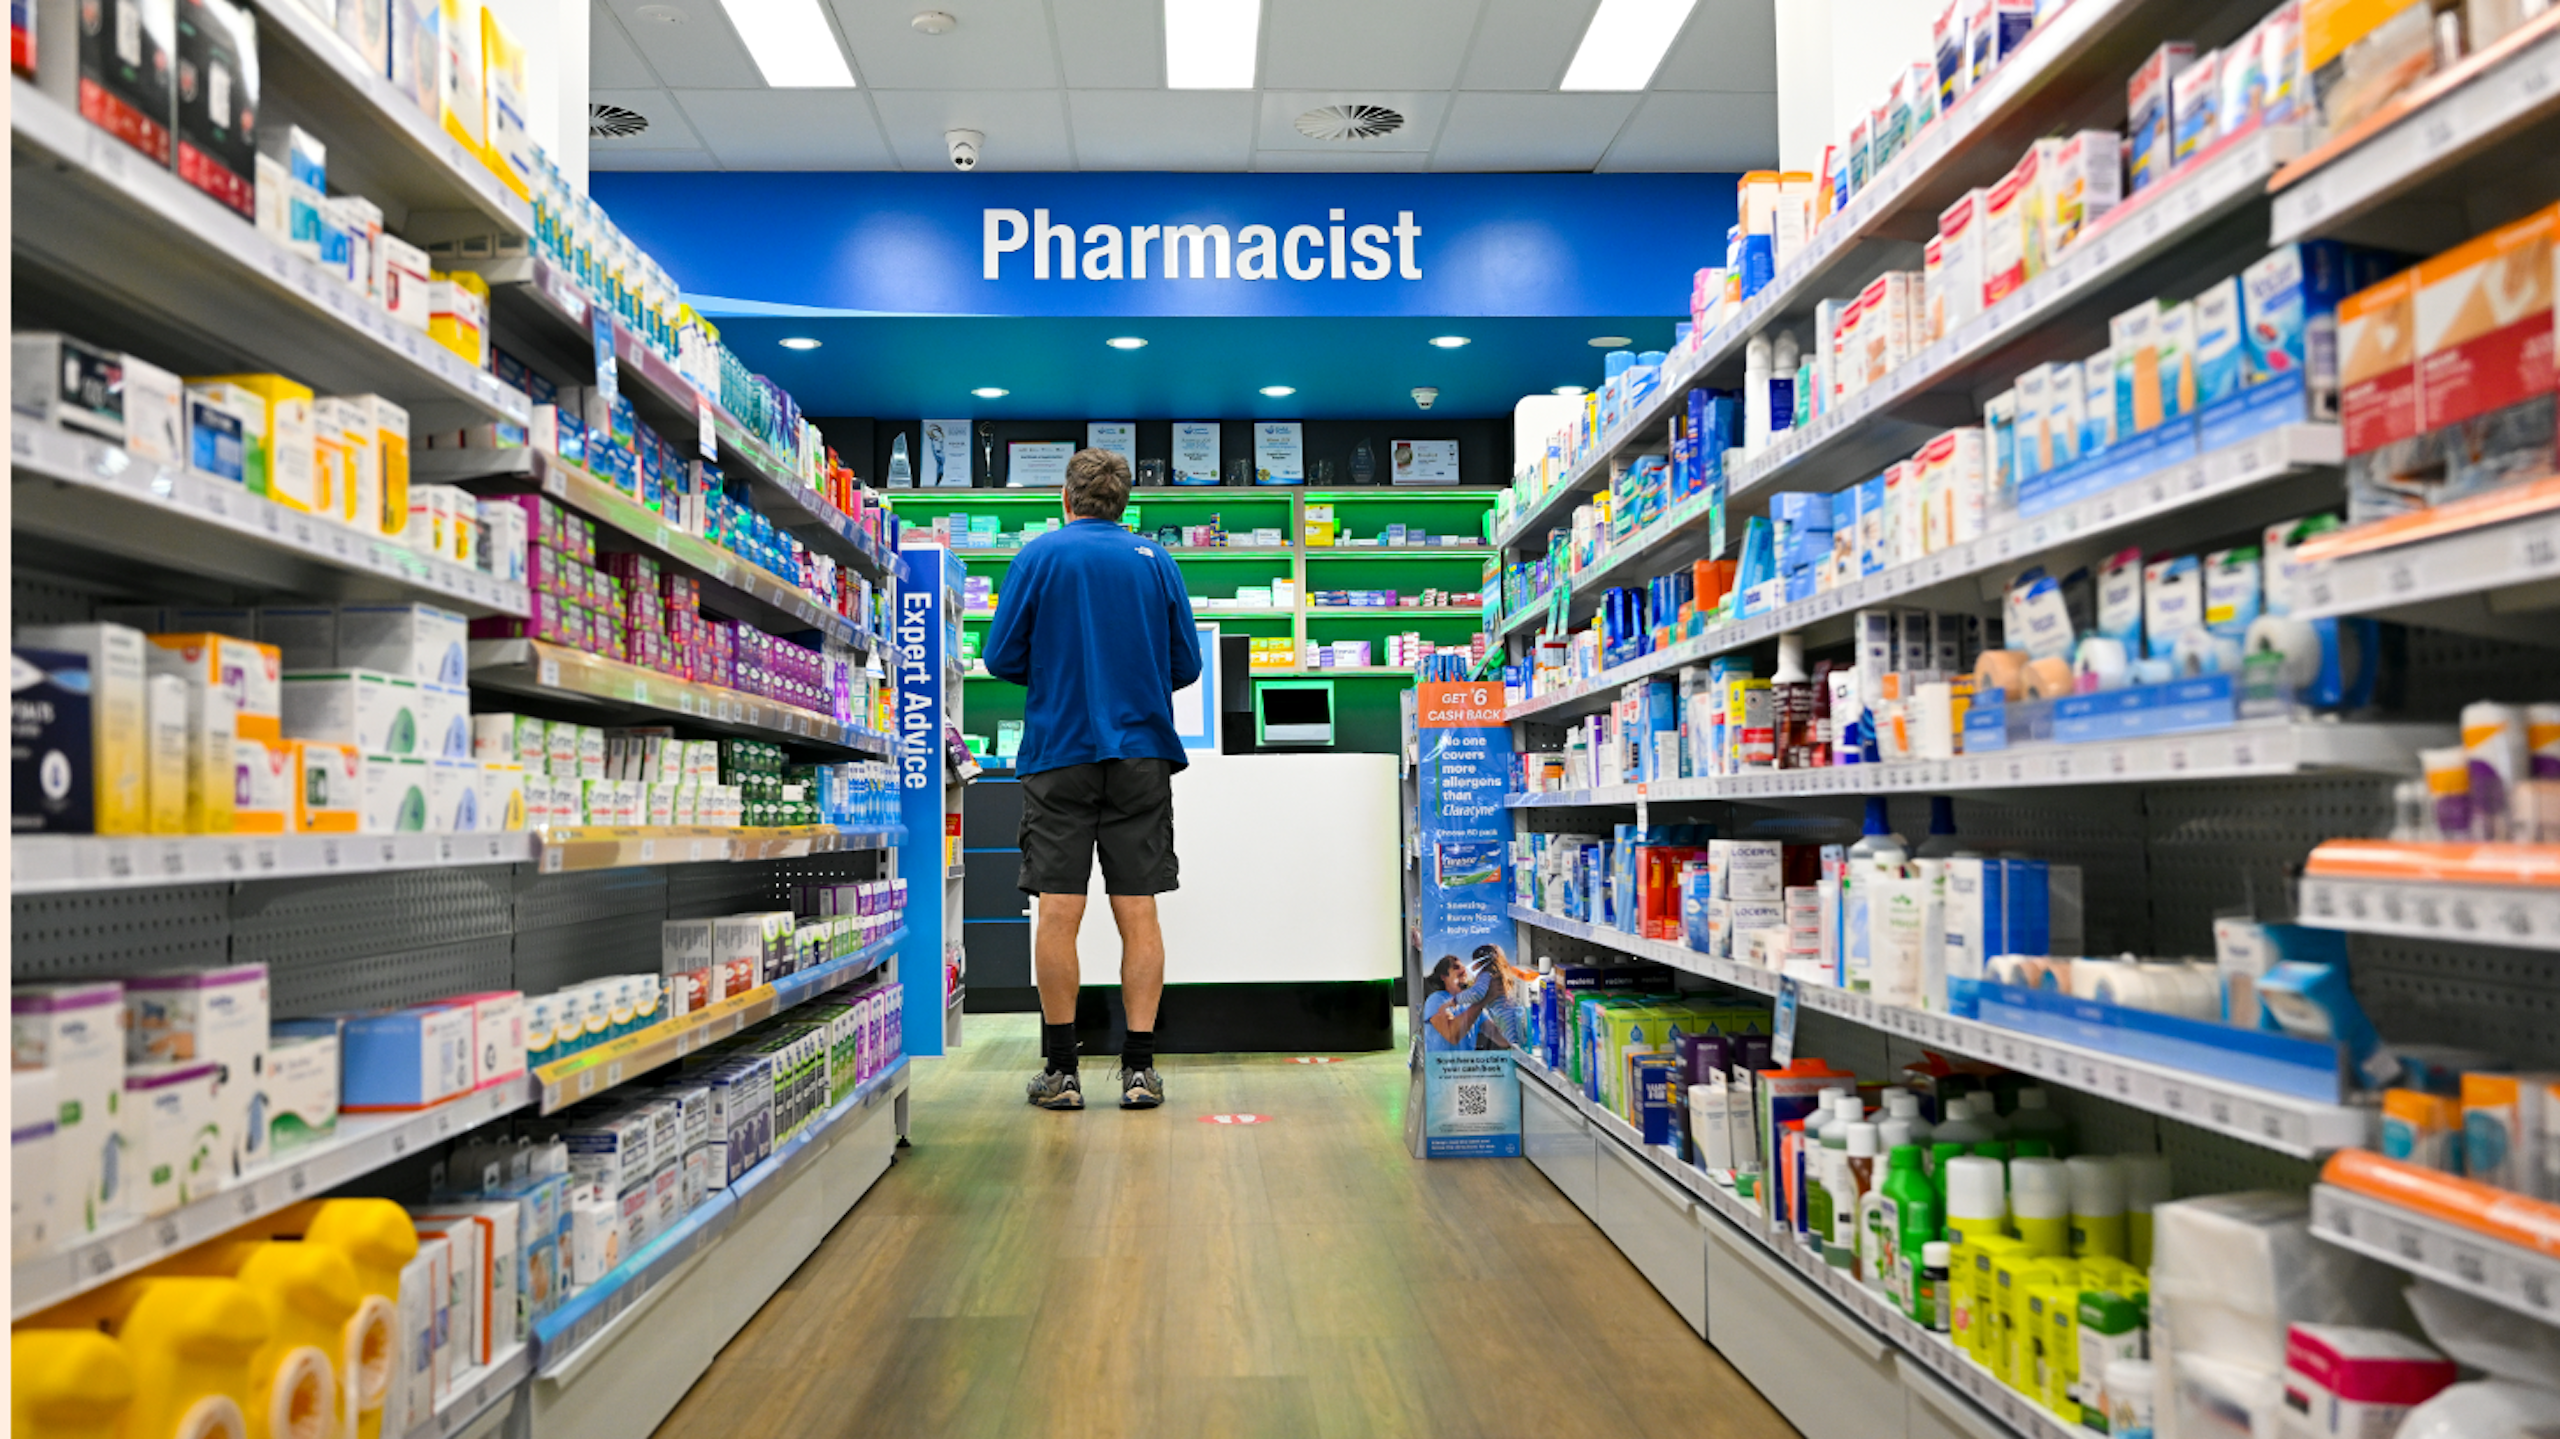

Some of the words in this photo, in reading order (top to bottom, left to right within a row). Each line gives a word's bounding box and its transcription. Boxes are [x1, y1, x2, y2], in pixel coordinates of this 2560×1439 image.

[983, 208, 1422, 281] Pharmacist
[898, 592, 932, 685] Expert
[1441, 693, 1468, 704] GET
[1427, 710, 1464, 721] CASH
[1466, 709, 1502, 720] BACK
[903, 691, 934, 789] Advice
[1462, 737, 1488, 746] one
[1442, 750, 1486, 761] covers
[1442, 764, 1477, 774] more
[1442, 776, 1502, 790] allergens
[1442, 790, 1472, 801] than
[1731, 848, 1778, 857] LOCERYL
[1735, 907, 1780, 917] LOCERYL
